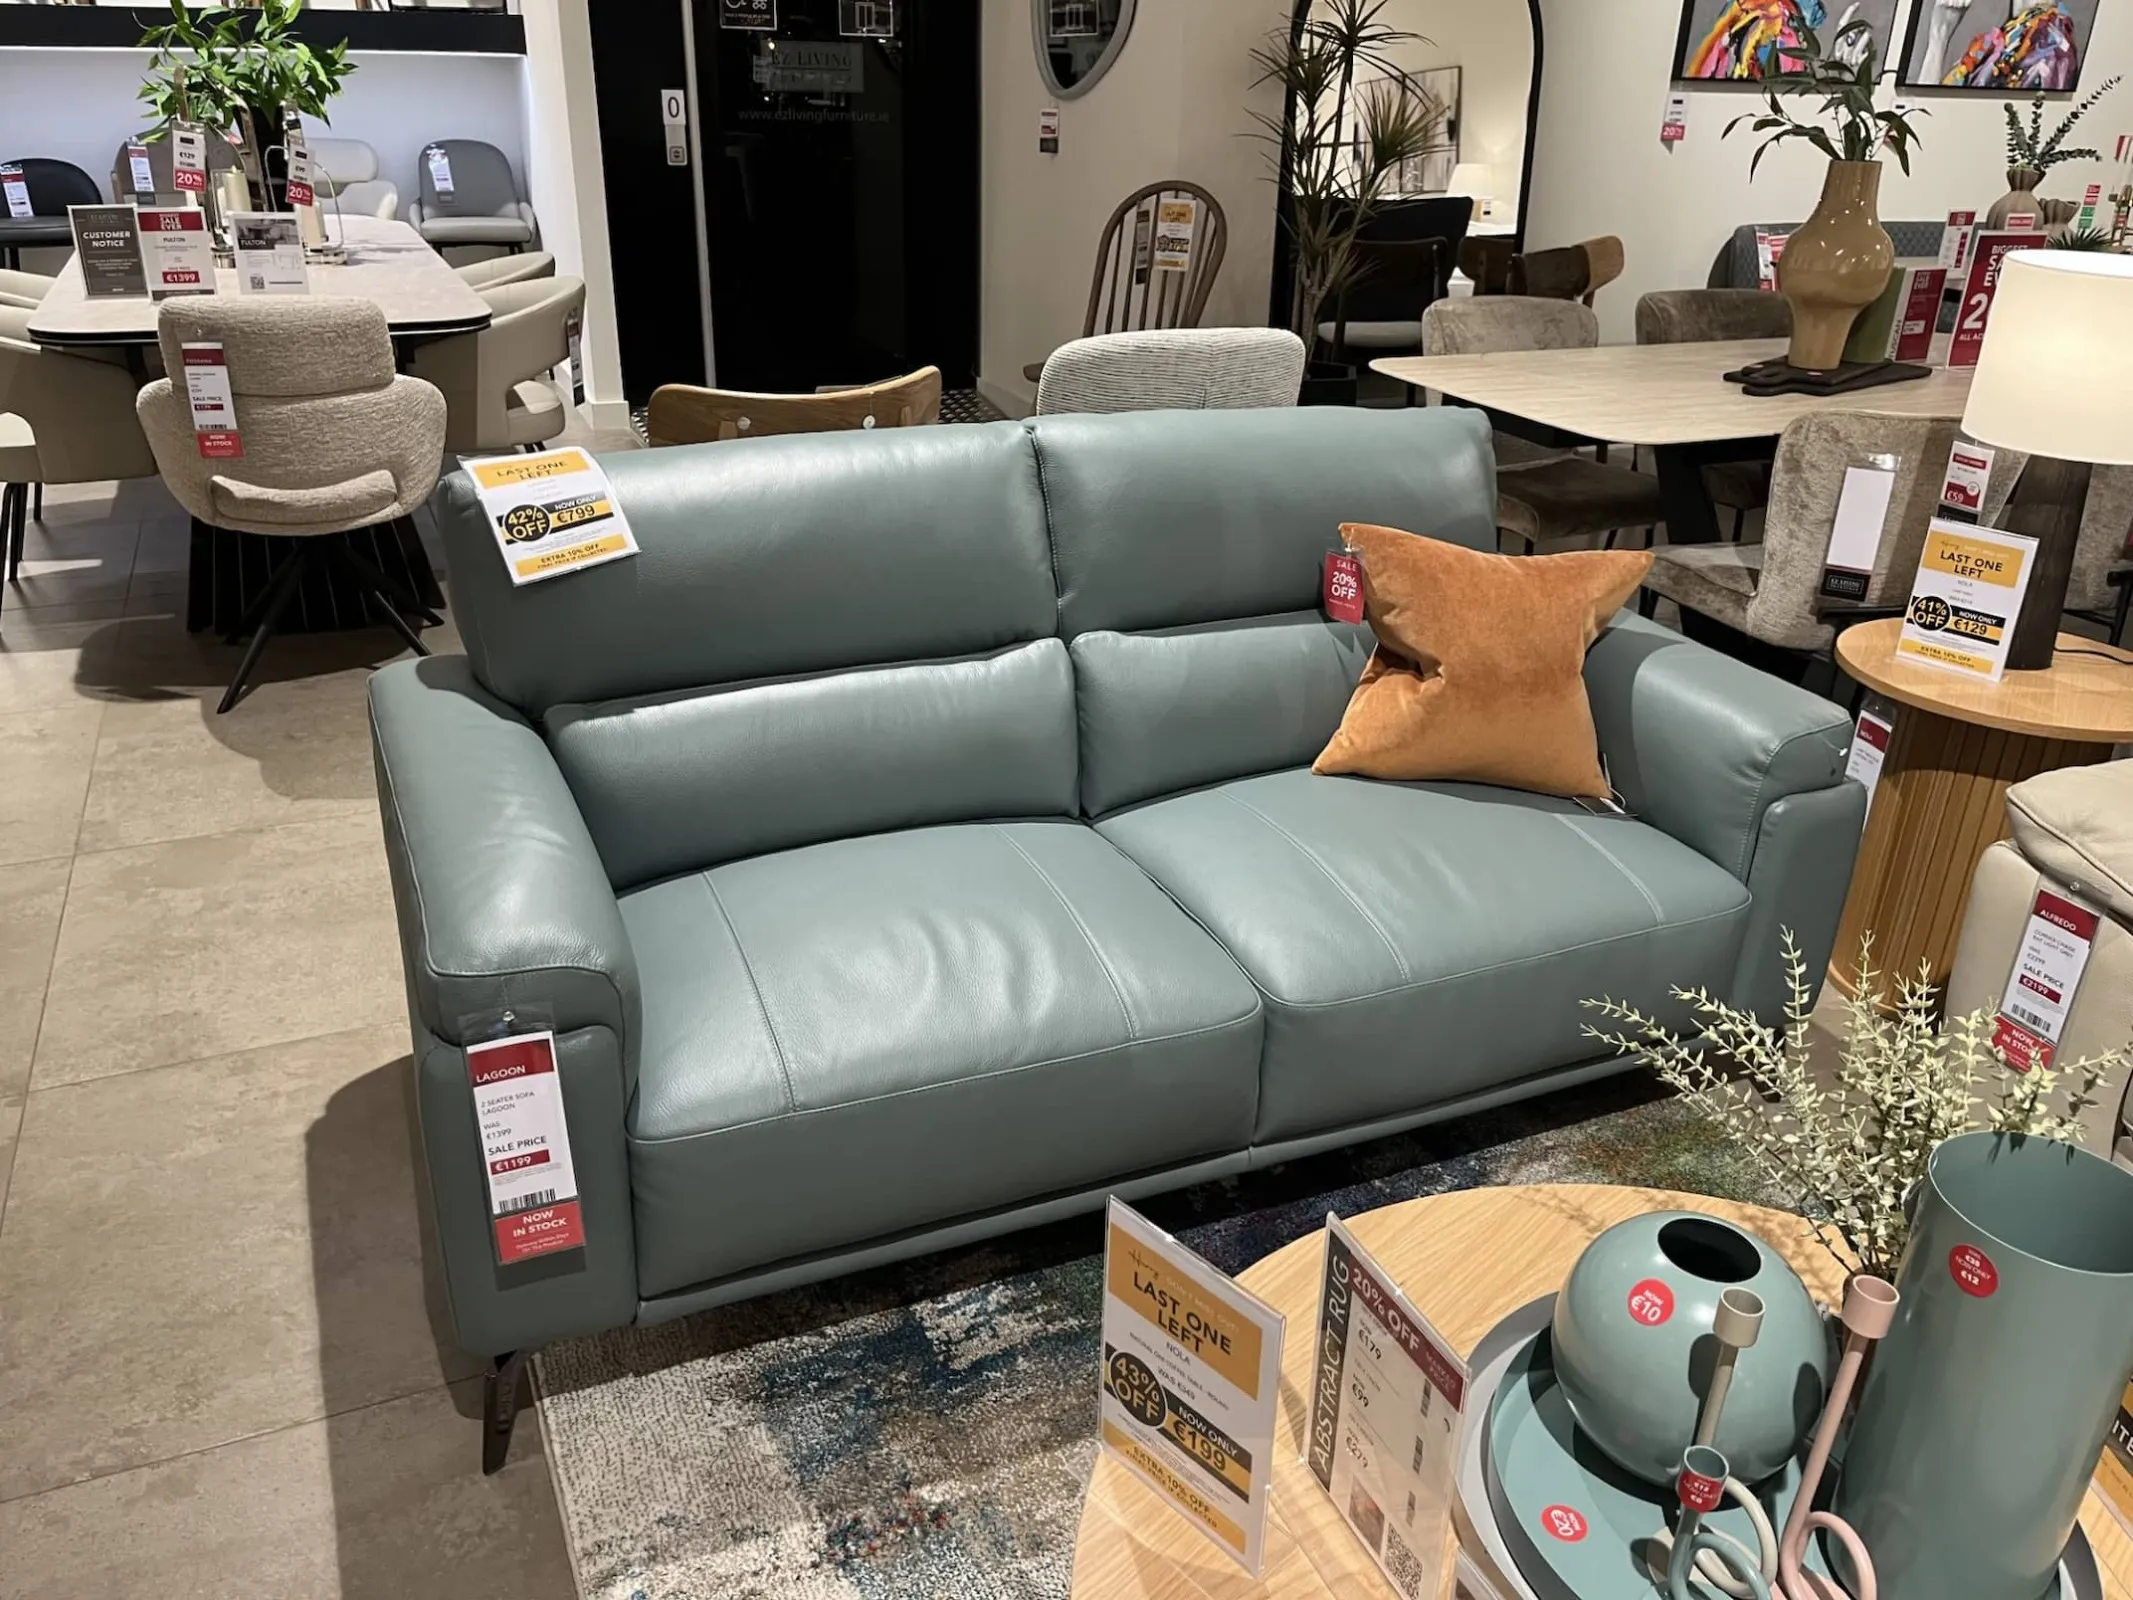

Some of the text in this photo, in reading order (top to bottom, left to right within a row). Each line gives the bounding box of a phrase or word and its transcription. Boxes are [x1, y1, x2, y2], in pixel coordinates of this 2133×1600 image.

[668, 97, 680, 118] 0
[83, 231, 130, 239] CUSTOMER
[92, 239, 125, 248] NOTICE
[166, 273, 196, 282] €1399
[497, 461, 568, 477] LAST ONE
[519, 470, 552, 480] LEFT
[555, 495, 597, 510] NOW ONLY
[1947, 490, 1964, 504] €59
[508, 507, 543, 525] 42%
[557, 505, 596, 523] €799
[512, 522, 548, 538] OFF
[541, 553, 566, 563] EXTRA
[585, 543, 600, 552] OFF
[1940, 550, 1971, 566] LAST
[1974, 558, 2003, 572] ONE
[1336, 560, 1357, 572] SALE
[1954, 565, 1984, 579] LEFT
[1332, 571, 1357, 588] 20%
[1331, 585, 1357, 600] OFF
[1918, 599, 1947, 616] 41%
[1915, 611, 1945, 627] OFF
[1953, 618, 1987, 636] €129
[1959, 611, 1998, 625] NOW ONLY
[2040, 909, 2077, 931] ALFREDO
[2023, 963, 2064, 989] SALE PRICE
[2022, 977, 2049, 994] €2199
[2002, 1033, 2011, 1043] IN
[476, 1065, 526, 1083] LAGOON
[487, 1094, 514, 1106] SEATER
[515, 1091, 535, 1100] SOFA
[482, 1103, 515, 1116] LAGOON
[483, 1122, 500, 1130] WAS
[486, 1128, 512, 1140] €1399
[488, 1135, 547, 1156] SALE PRICE
[495, 1156, 532, 1171] €1199
[522, 1210, 554, 1224] NOW
[513, 1218, 568, 1237] IN STOCK
[1961, 1270, 1979, 1286] €12
[1643, 1289, 1664, 1306] NOW
[1134, 1271, 1231, 1356] LAST ONE
[1352, 1268, 1385, 1316] 20%
[1388, 1309, 1420, 1350] OFF
[1632, 1295, 1661, 1322] €10
[1158, 1309, 1204, 1353] LEFT
[1358, 1329, 1381, 1360] €179
[1166, 1342, 1191, 1366] NOLA
[1315, 1256, 1349, 1473] ABSTRACT RUG
[1115, 1358, 1160, 1400] 43%
[1158, 1367, 1175, 1385] WAS
[1115, 1378, 1159, 1419] OFF
[1352, 1383, 1369, 1407] €99
[1178, 1407, 1237, 1457] NOW ONLY
[1173, 1419, 1226, 1471] €199
[1134, 1446, 1210, 1513] EXTRA 10% OFF
[1551, 1509, 1574, 1536] €20
